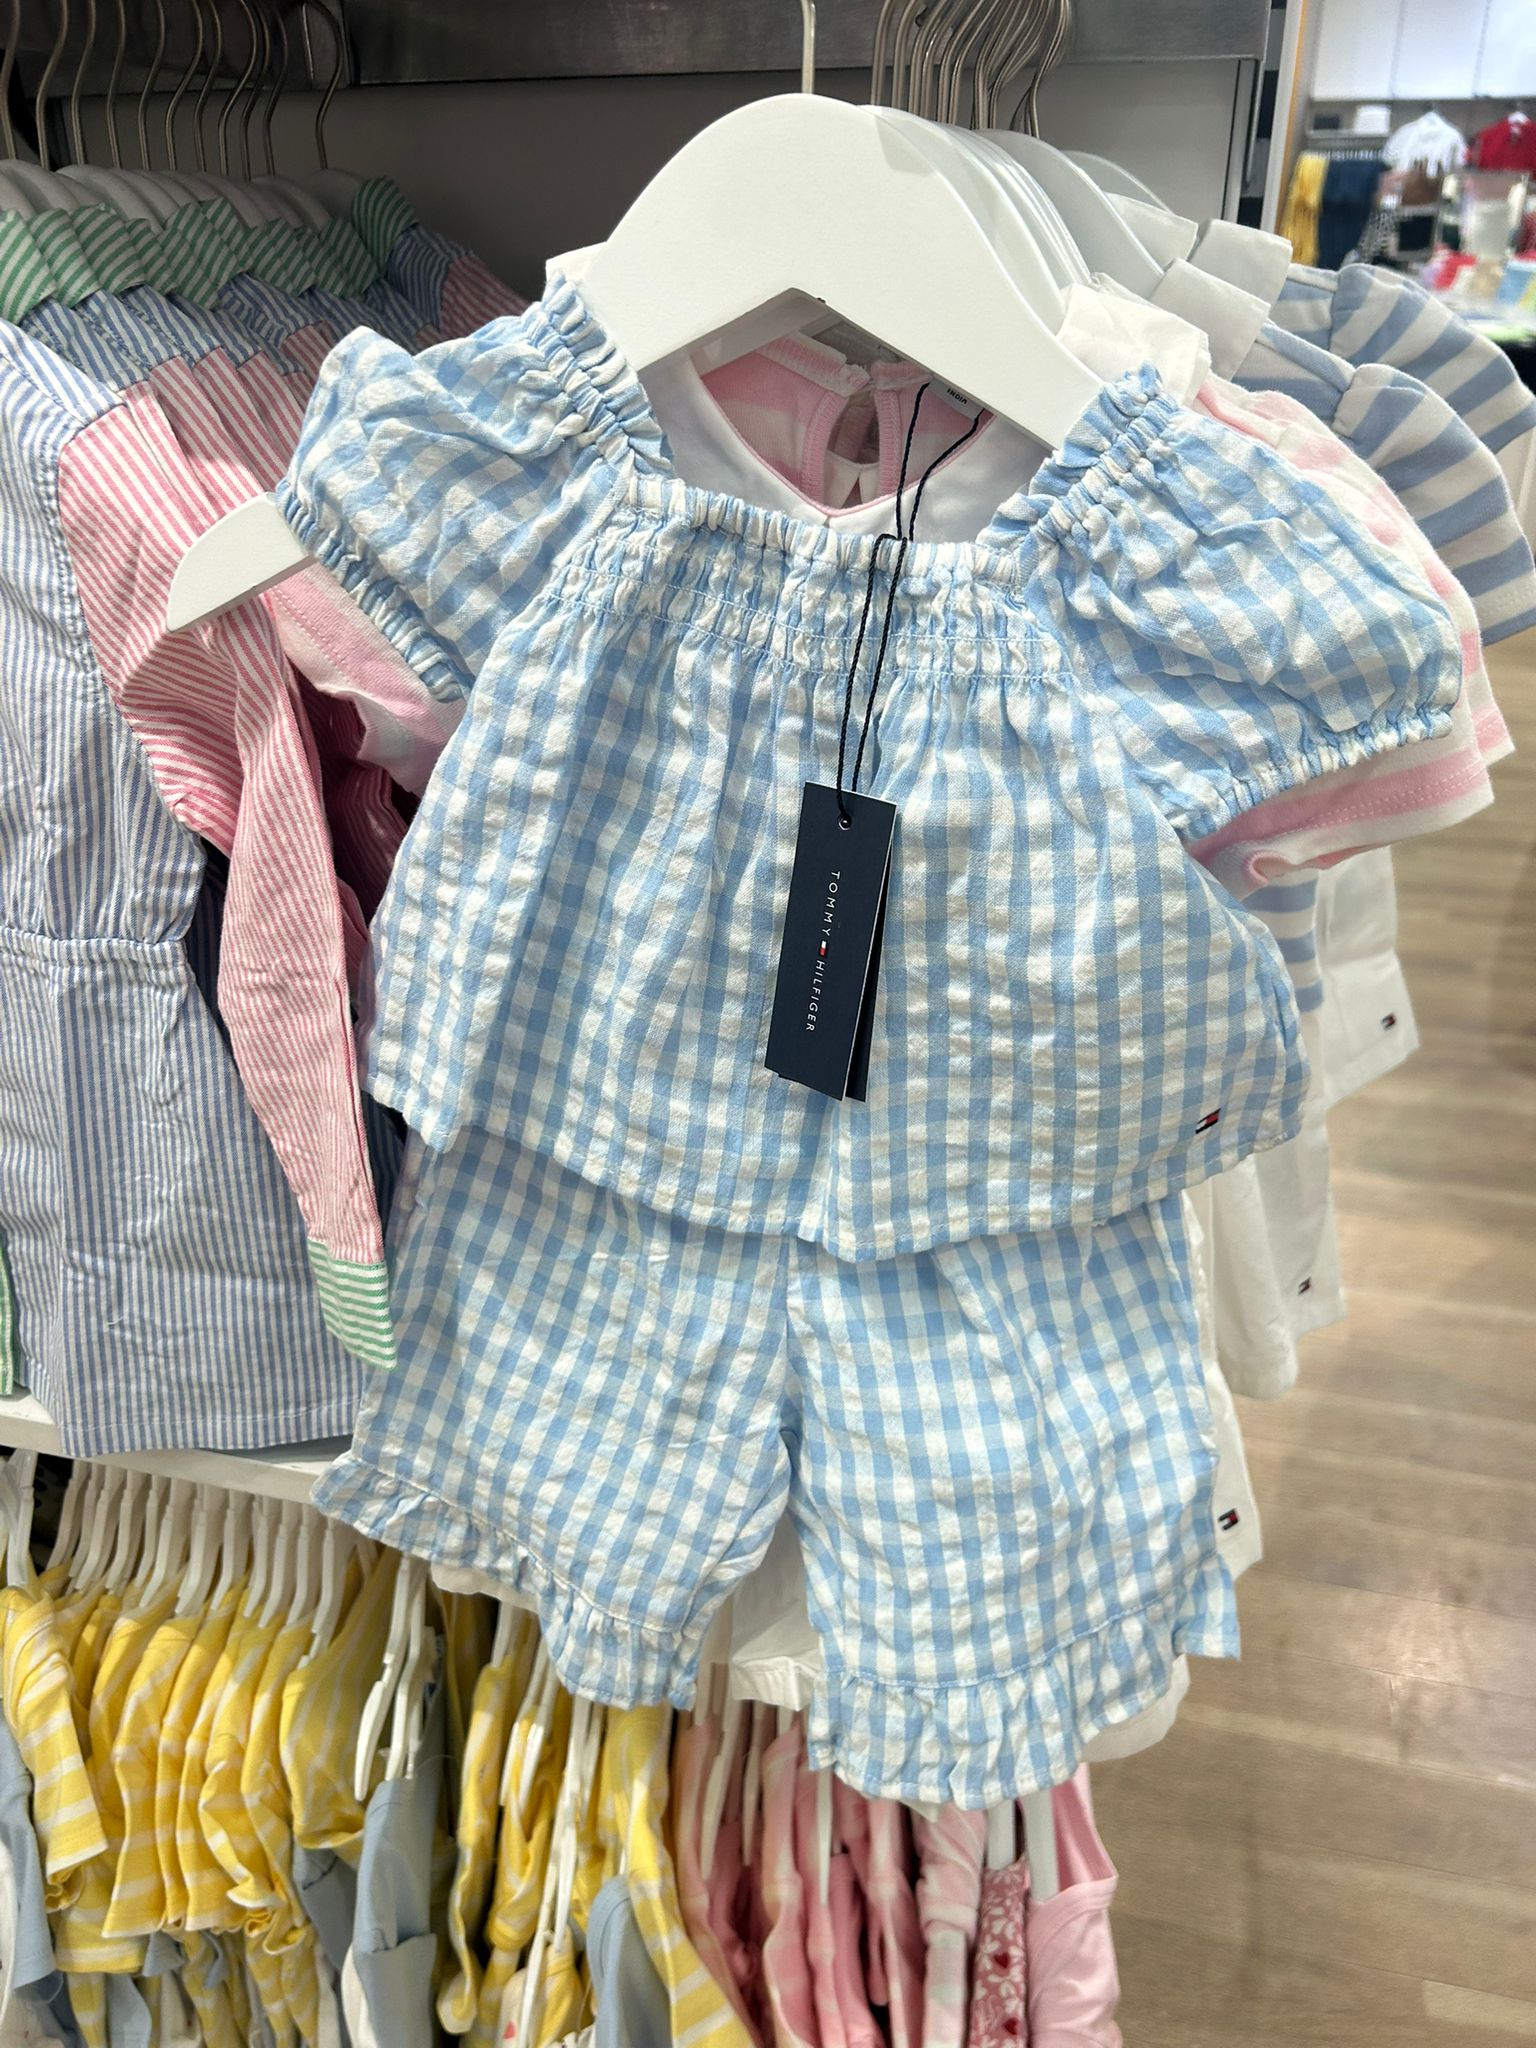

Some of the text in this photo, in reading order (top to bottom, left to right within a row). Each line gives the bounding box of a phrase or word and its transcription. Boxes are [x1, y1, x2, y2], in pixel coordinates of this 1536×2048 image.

[946, 388, 968, 405] INDIA
[805, 870, 841, 1032] TOMMY HILFIGER
